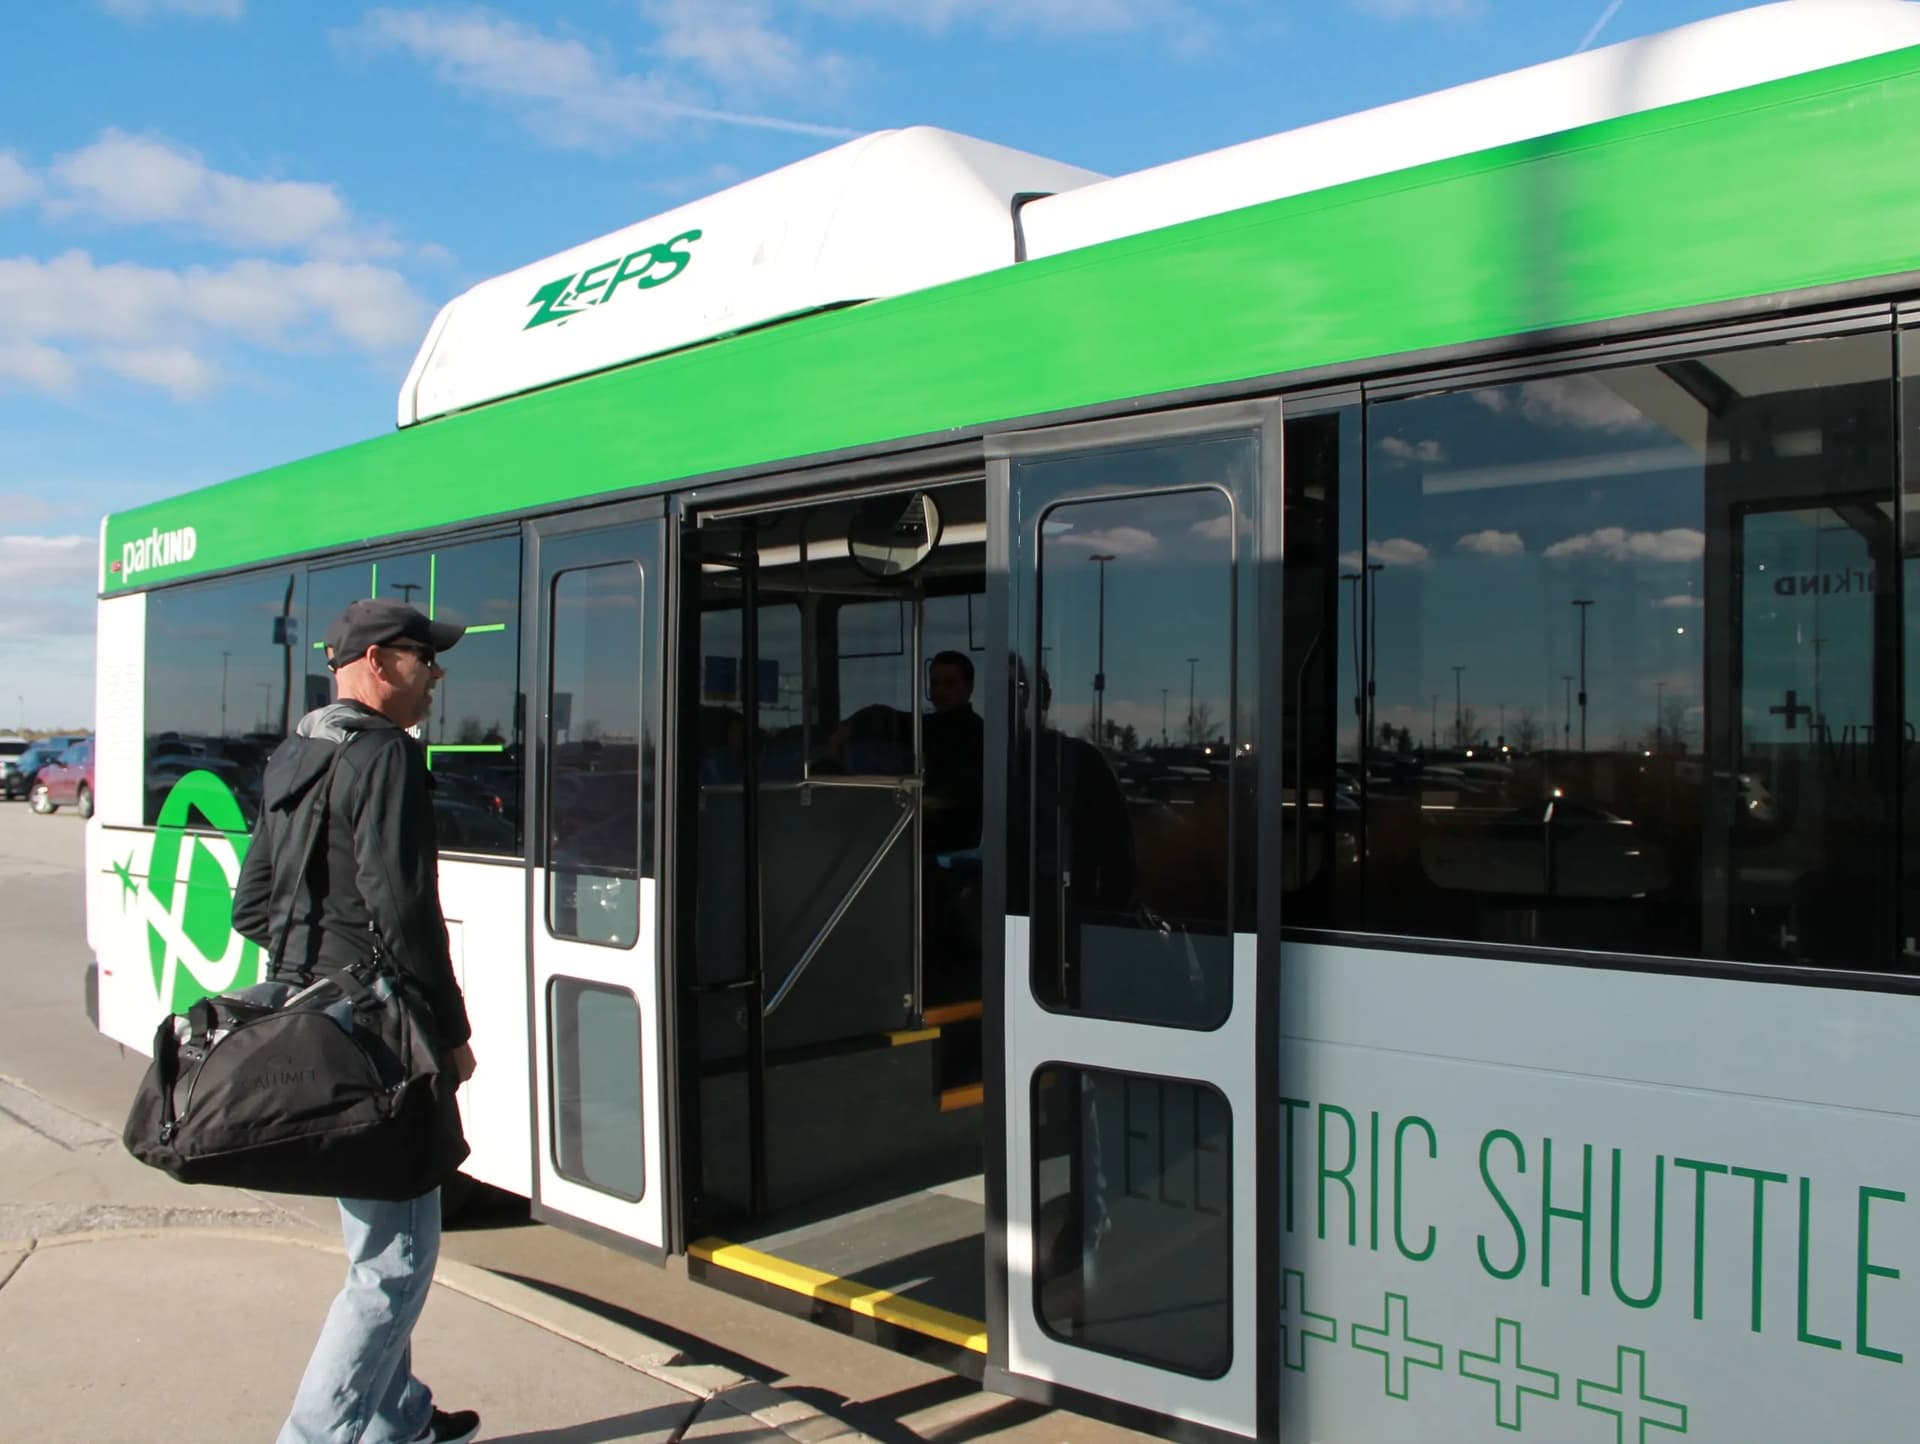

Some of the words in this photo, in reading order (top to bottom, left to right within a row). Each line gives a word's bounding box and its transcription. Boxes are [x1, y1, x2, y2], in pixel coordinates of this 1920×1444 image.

[522, 228, 702, 330] ZEPS
[122, 526, 197, 584] parkIND
[1477, 1129, 1907, 1364] SHUTTLE
